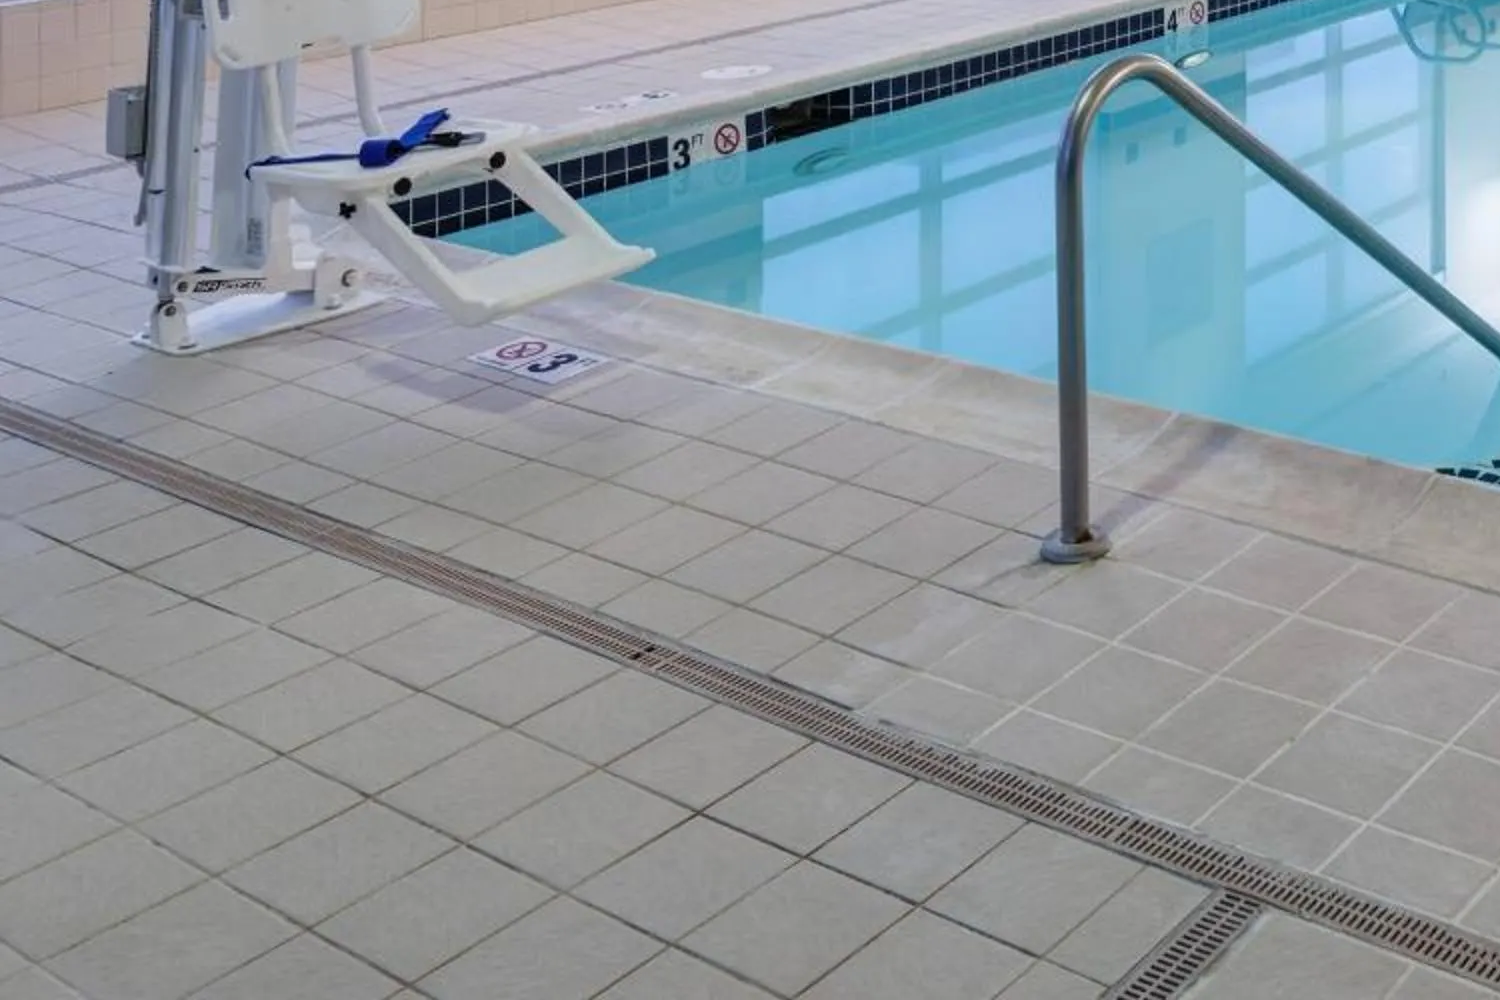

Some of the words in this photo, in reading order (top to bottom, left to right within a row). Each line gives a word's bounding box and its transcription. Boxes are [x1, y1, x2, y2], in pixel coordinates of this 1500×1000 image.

[1168, 9, 1178, 32] 4
[673, 138, 691, 170] 3
[692, 133, 704, 149] FT
[528, 354, 578, 372] 3
